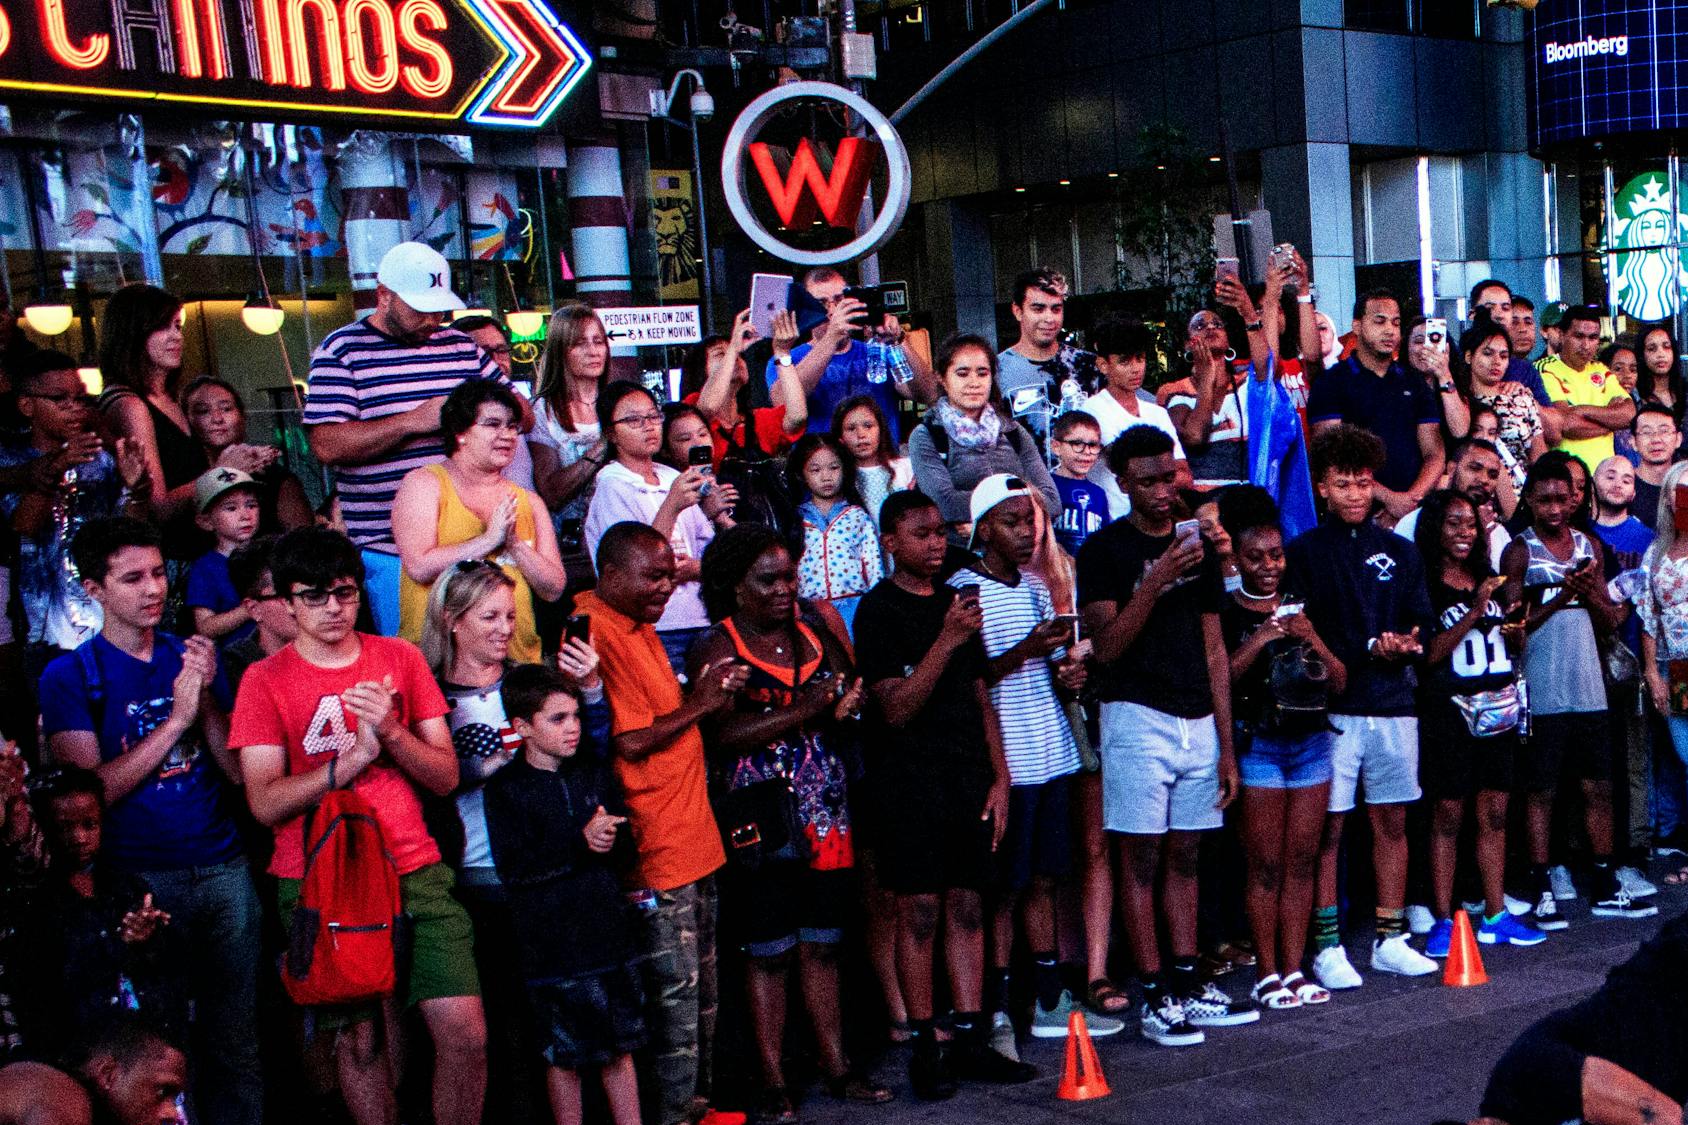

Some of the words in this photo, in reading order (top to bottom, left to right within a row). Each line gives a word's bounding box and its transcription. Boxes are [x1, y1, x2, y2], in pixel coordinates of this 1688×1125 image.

[1545, 34, 1628, 64] Bloomberg
[748, 136, 870, 228] W
[604, 313, 651, 326] PEDESTRIAN
[653, 312, 673, 324] FLOW
[675, 311, 694, 323] ZONE
[647, 328, 666, 339] KEEP
[668, 326, 696, 338] MOVING
[1452, 624, 1513, 677] 01
